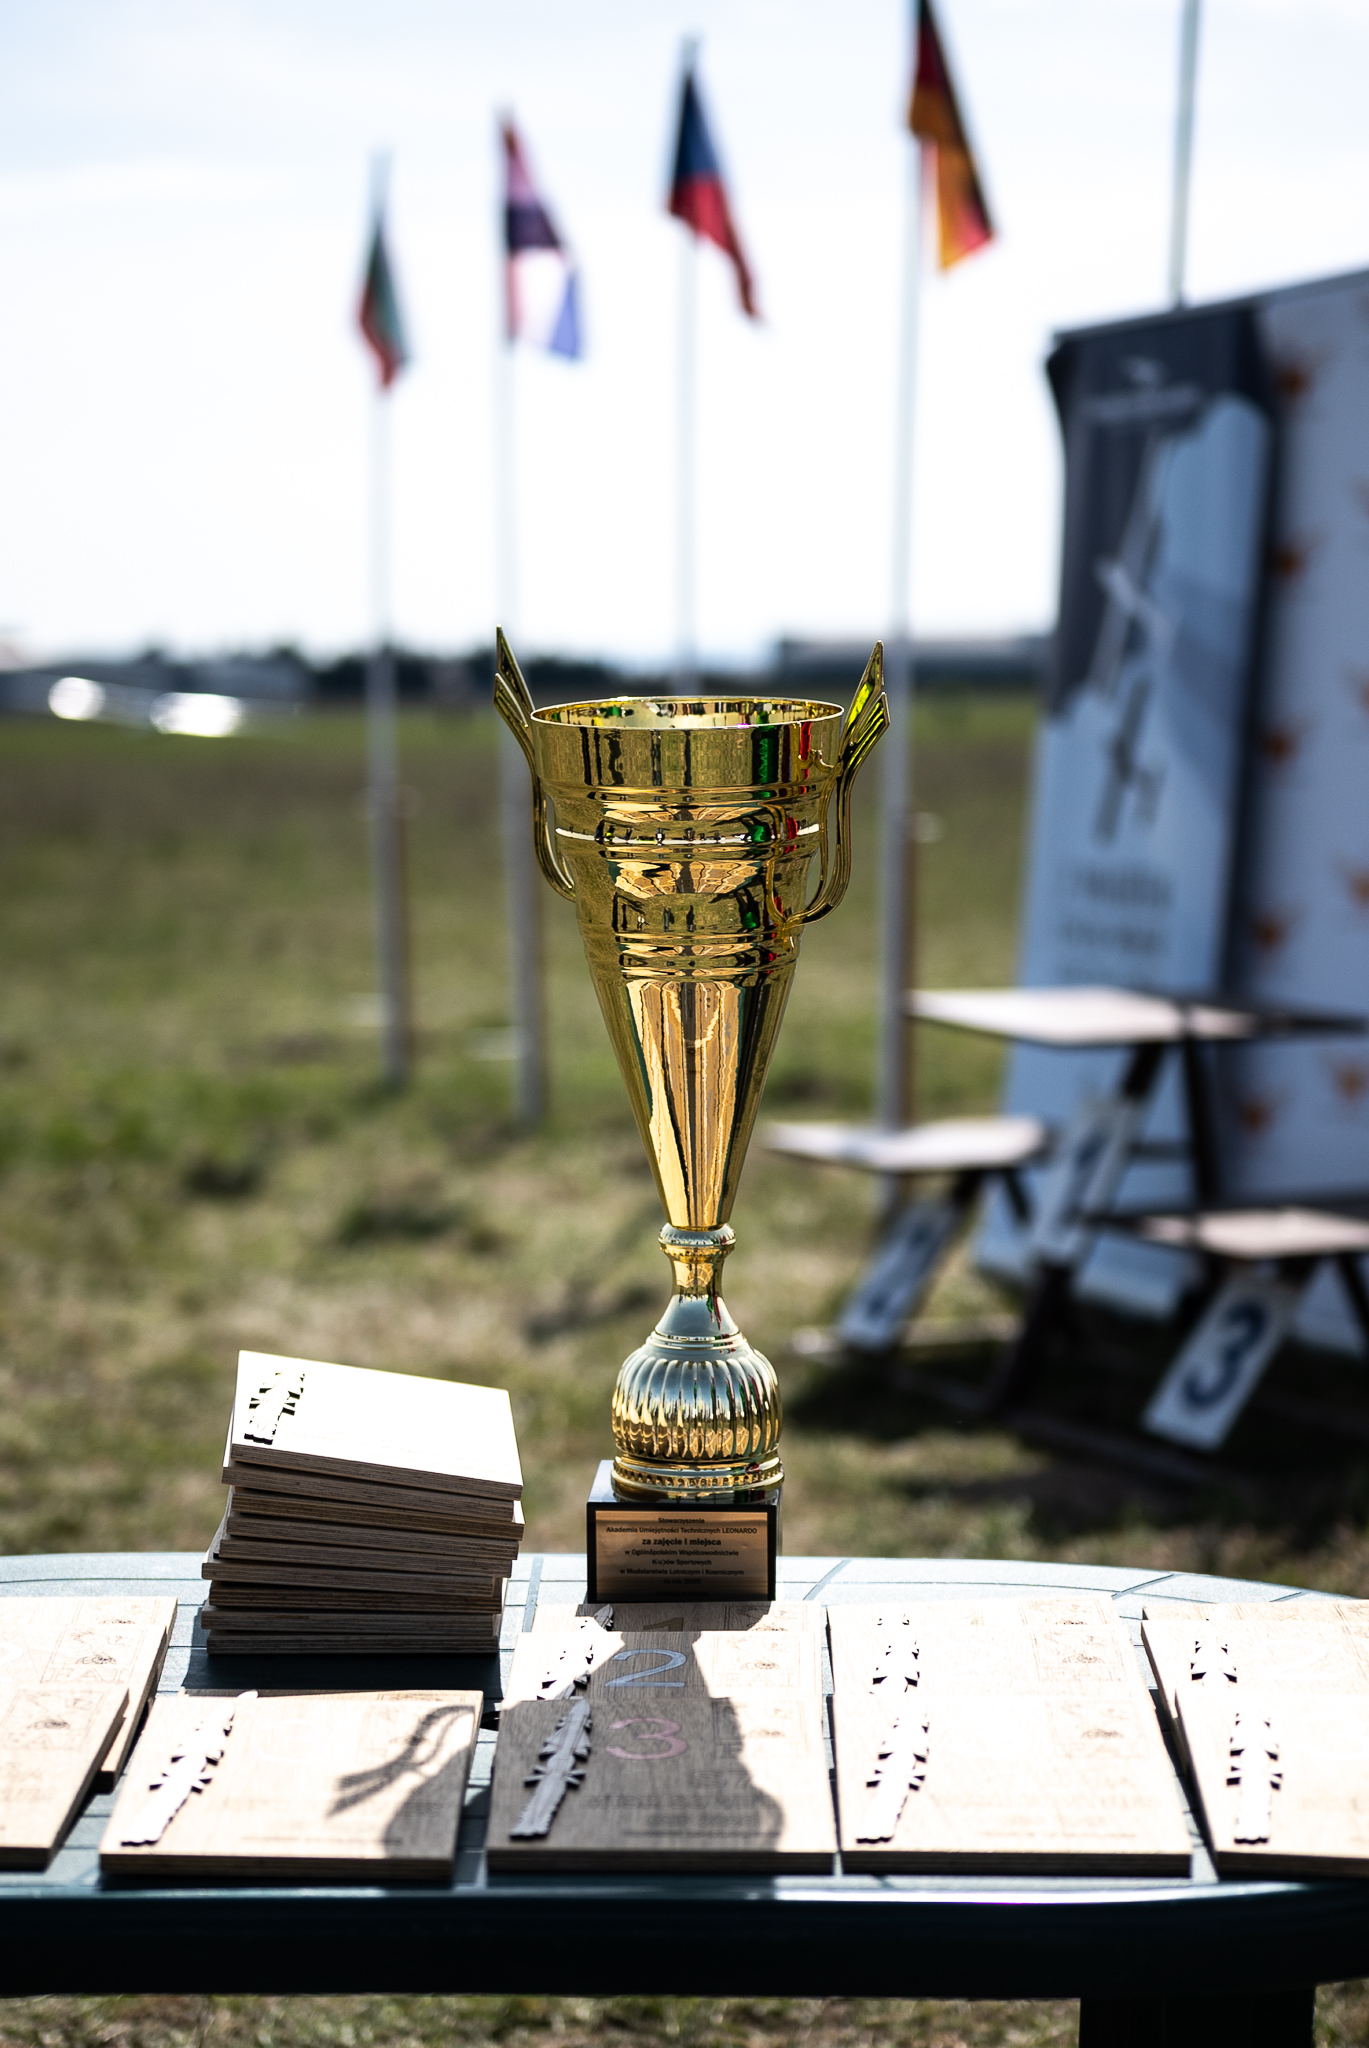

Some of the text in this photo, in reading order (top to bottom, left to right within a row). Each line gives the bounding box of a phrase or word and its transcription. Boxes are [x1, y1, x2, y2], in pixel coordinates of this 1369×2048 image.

[1180, 1298, 1270, 1411] 3
[658, 1517, 705, 1525] Stowarzyszenie
[639, 1527, 680, 1535] Umiejętności
[681, 1527, 721, 1535] Technicznych
[653, 1537, 683, 1547] zajęcie
[689, 1538, 722, 1547] miejsca
[676, 1559, 712, 1567] Sportowych
[669, 1568, 701, 1576] Lotniczym
[705, 1569, 745, 1577] Kosmicznym
[604, 1649, 687, 1687] 2
[606, 1717, 688, 1760] 3
